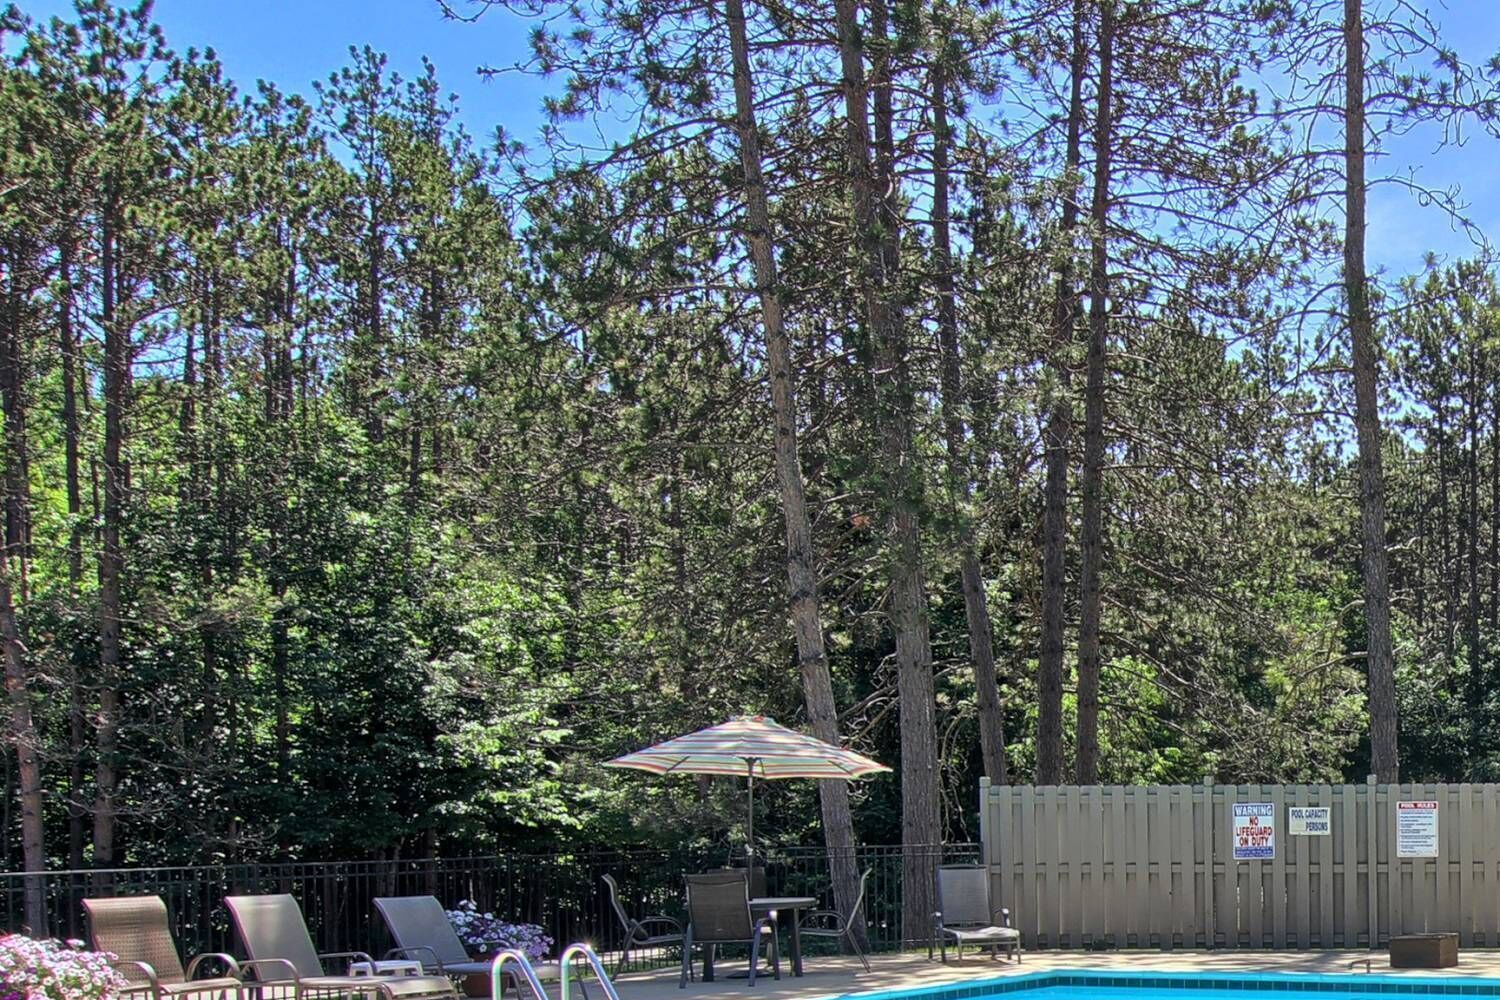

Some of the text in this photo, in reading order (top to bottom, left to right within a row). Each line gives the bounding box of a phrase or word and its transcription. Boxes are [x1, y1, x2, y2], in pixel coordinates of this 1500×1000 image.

[1235, 805, 1272, 816] WARNING
[1291, 809, 1328, 819] POOL CAPACITY
[1249, 816, 1259, 826] NO
[1236, 826, 1273, 837] LIFEGUARD
[1306, 821, 1328, 832] PERSONS
[1239, 837, 1269, 847] ON DUTY
